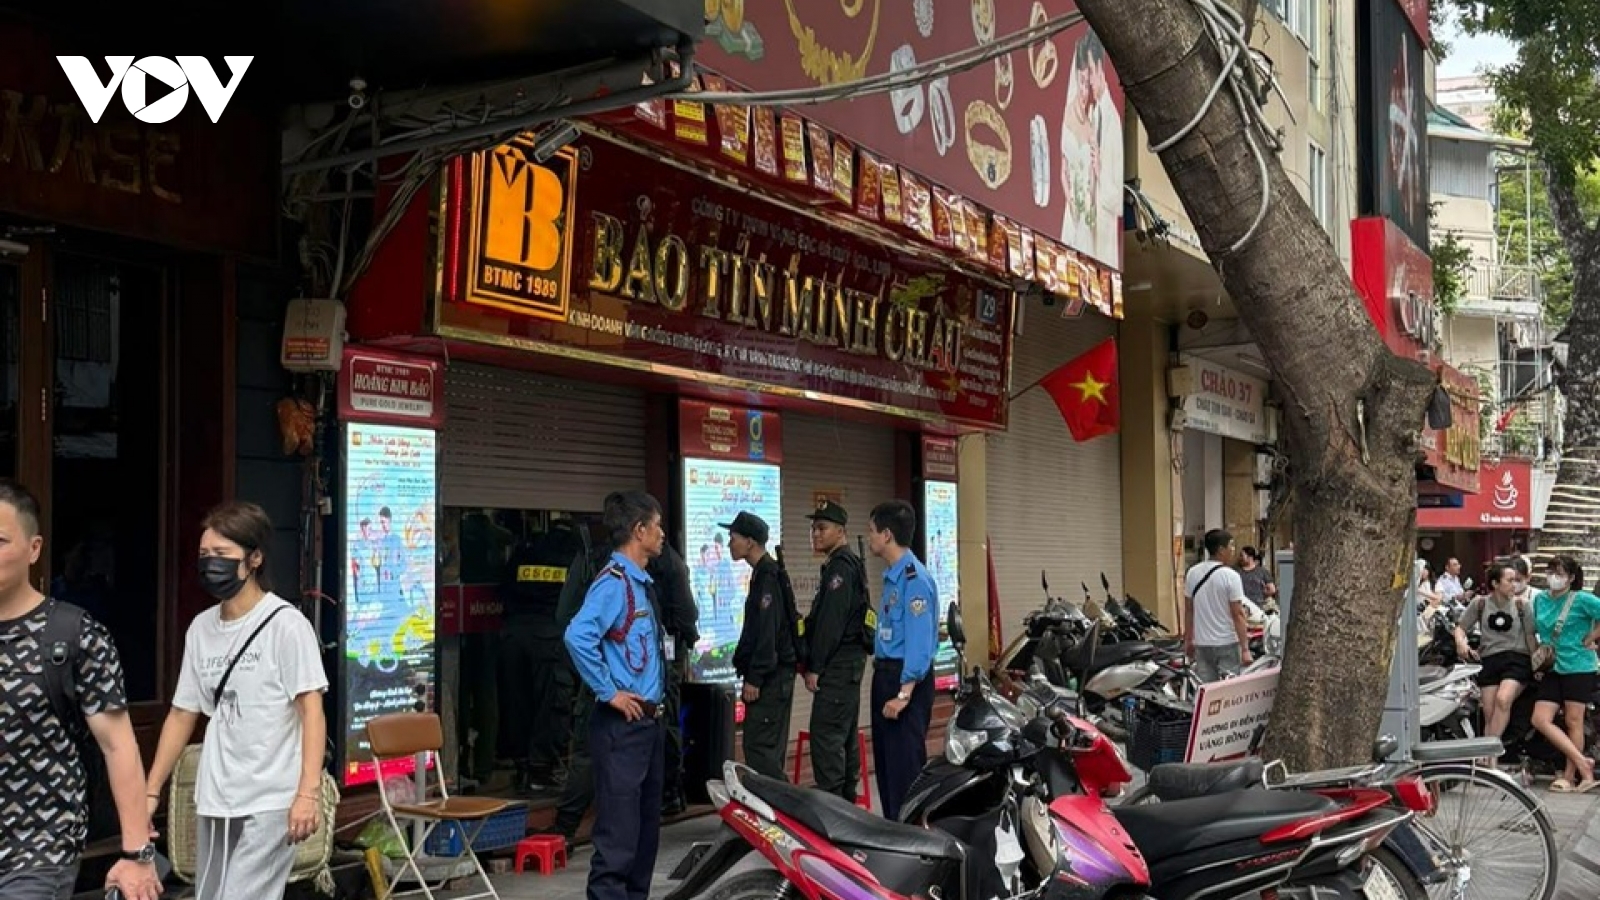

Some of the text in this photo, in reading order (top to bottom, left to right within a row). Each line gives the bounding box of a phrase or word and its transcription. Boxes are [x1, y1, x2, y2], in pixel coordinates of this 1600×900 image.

[483, 264, 558, 299] BTMC 1989
[587, 194, 690, 312] BẢO
[698, 233, 776, 332] TÍN
[779, 268, 878, 356] MINH
[982, 294, 996, 319] 29
[569, 308, 591, 328] KINH
[591, 314, 624, 336] DOANH
[1238, 381, 1253, 405] 37
